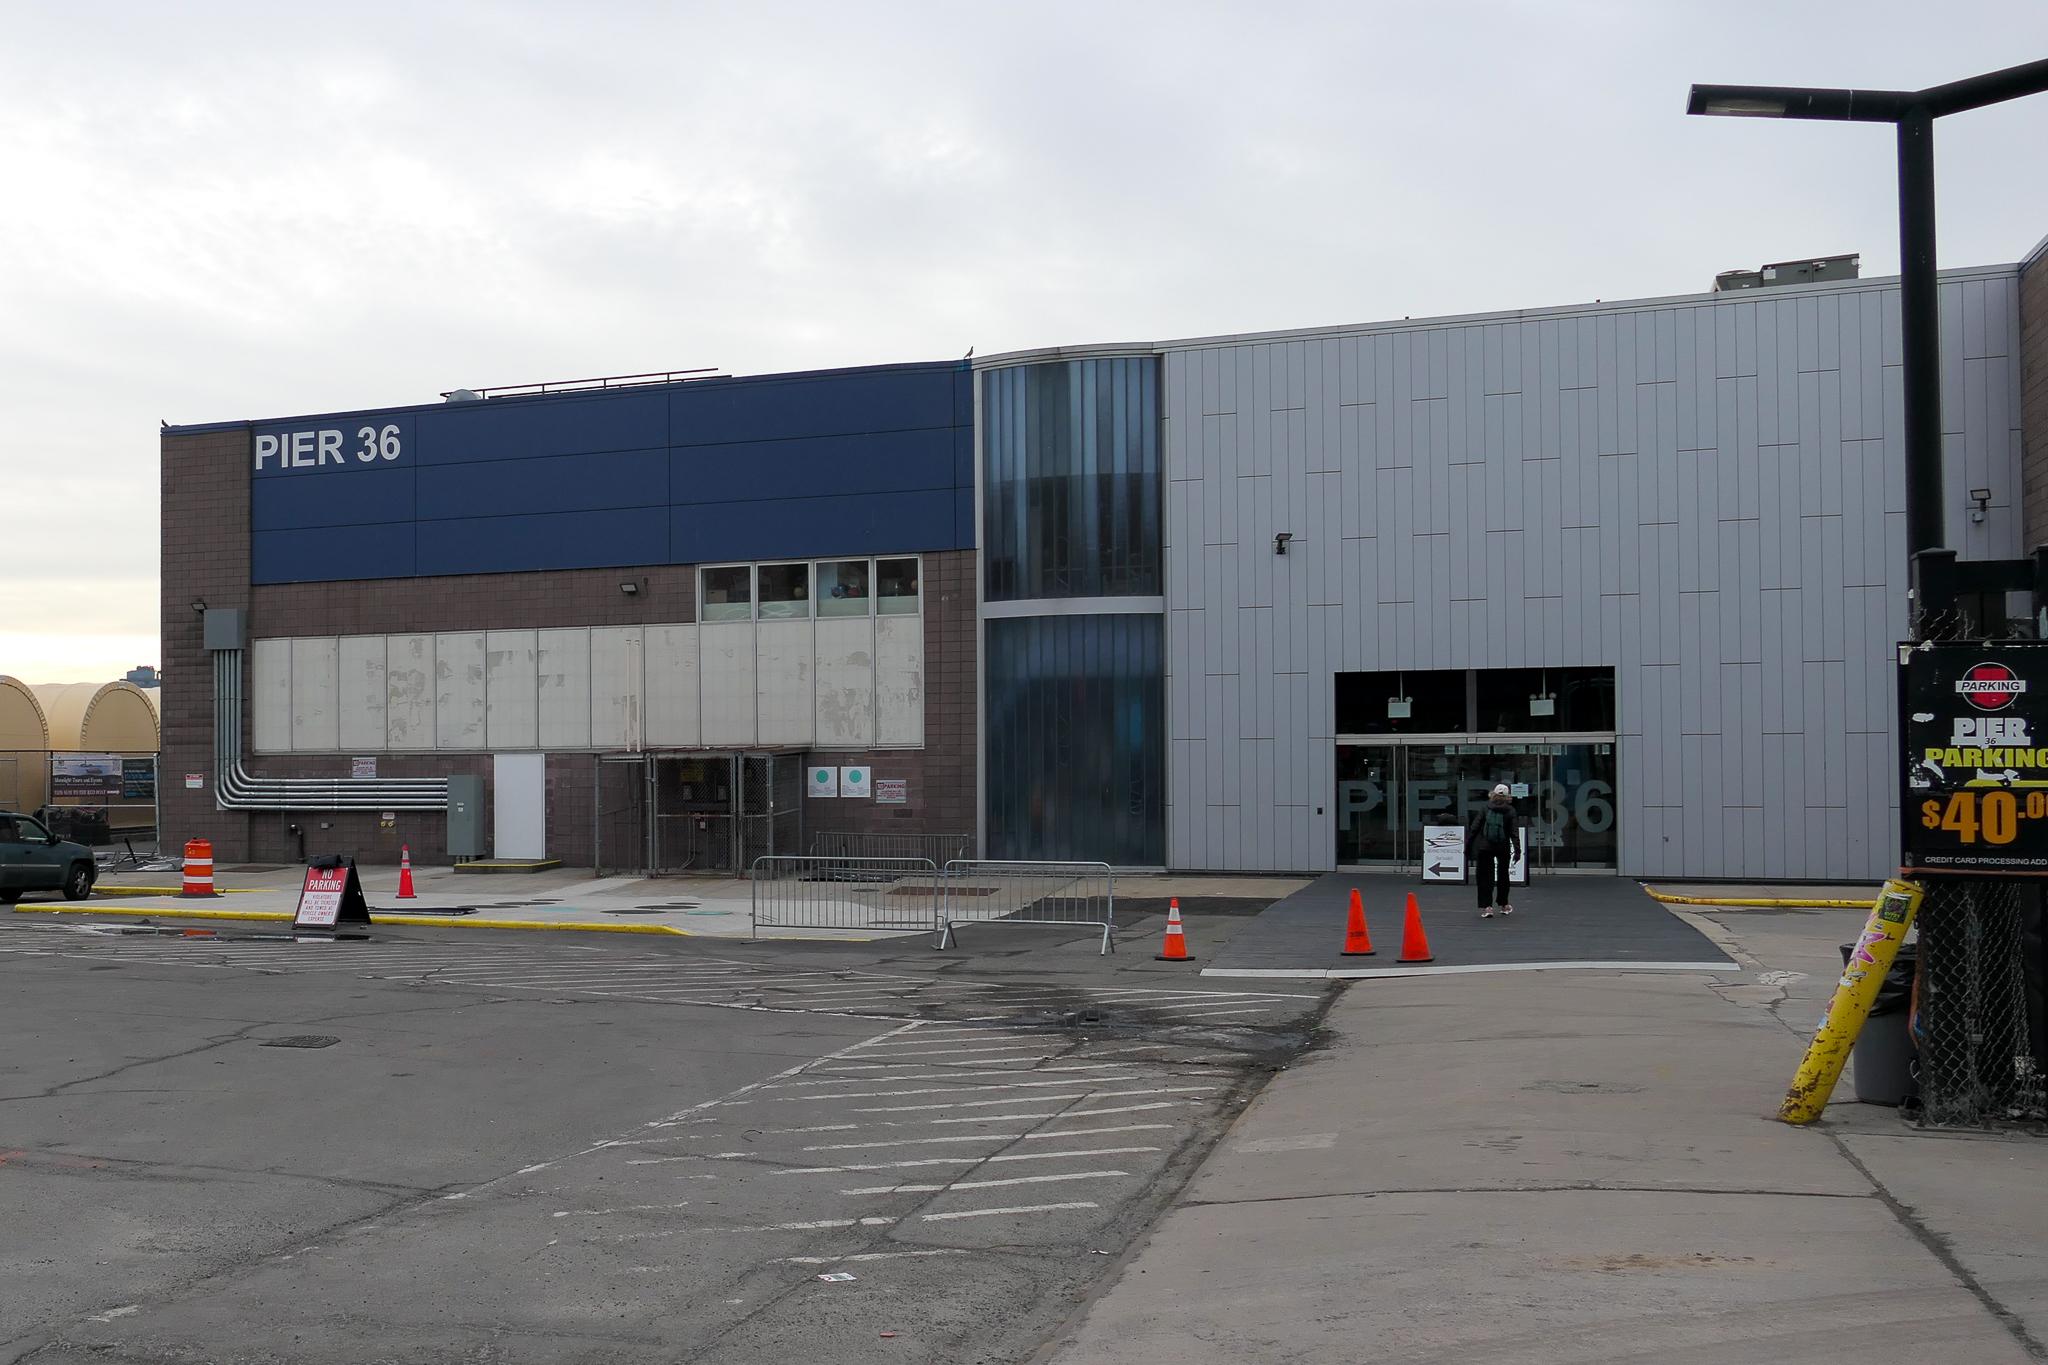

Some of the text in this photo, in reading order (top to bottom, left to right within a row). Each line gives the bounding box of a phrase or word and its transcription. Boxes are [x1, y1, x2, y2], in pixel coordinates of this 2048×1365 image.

[255, 424, 401, 470] PIER 36
[1961, 682, 2020, 691] PARKING
[1953, 717, 2027, 738] PIER
[1531, 779, 1614, 833] 36
[1924, 856, 1953, 864] CREDIT
[1954, 856, 1980, 864] CARD
[1978, 857, 2029, 865] PROCESSING
[321, 869, 334, 879] NO
[308, 880, 341, 891] PARKING
